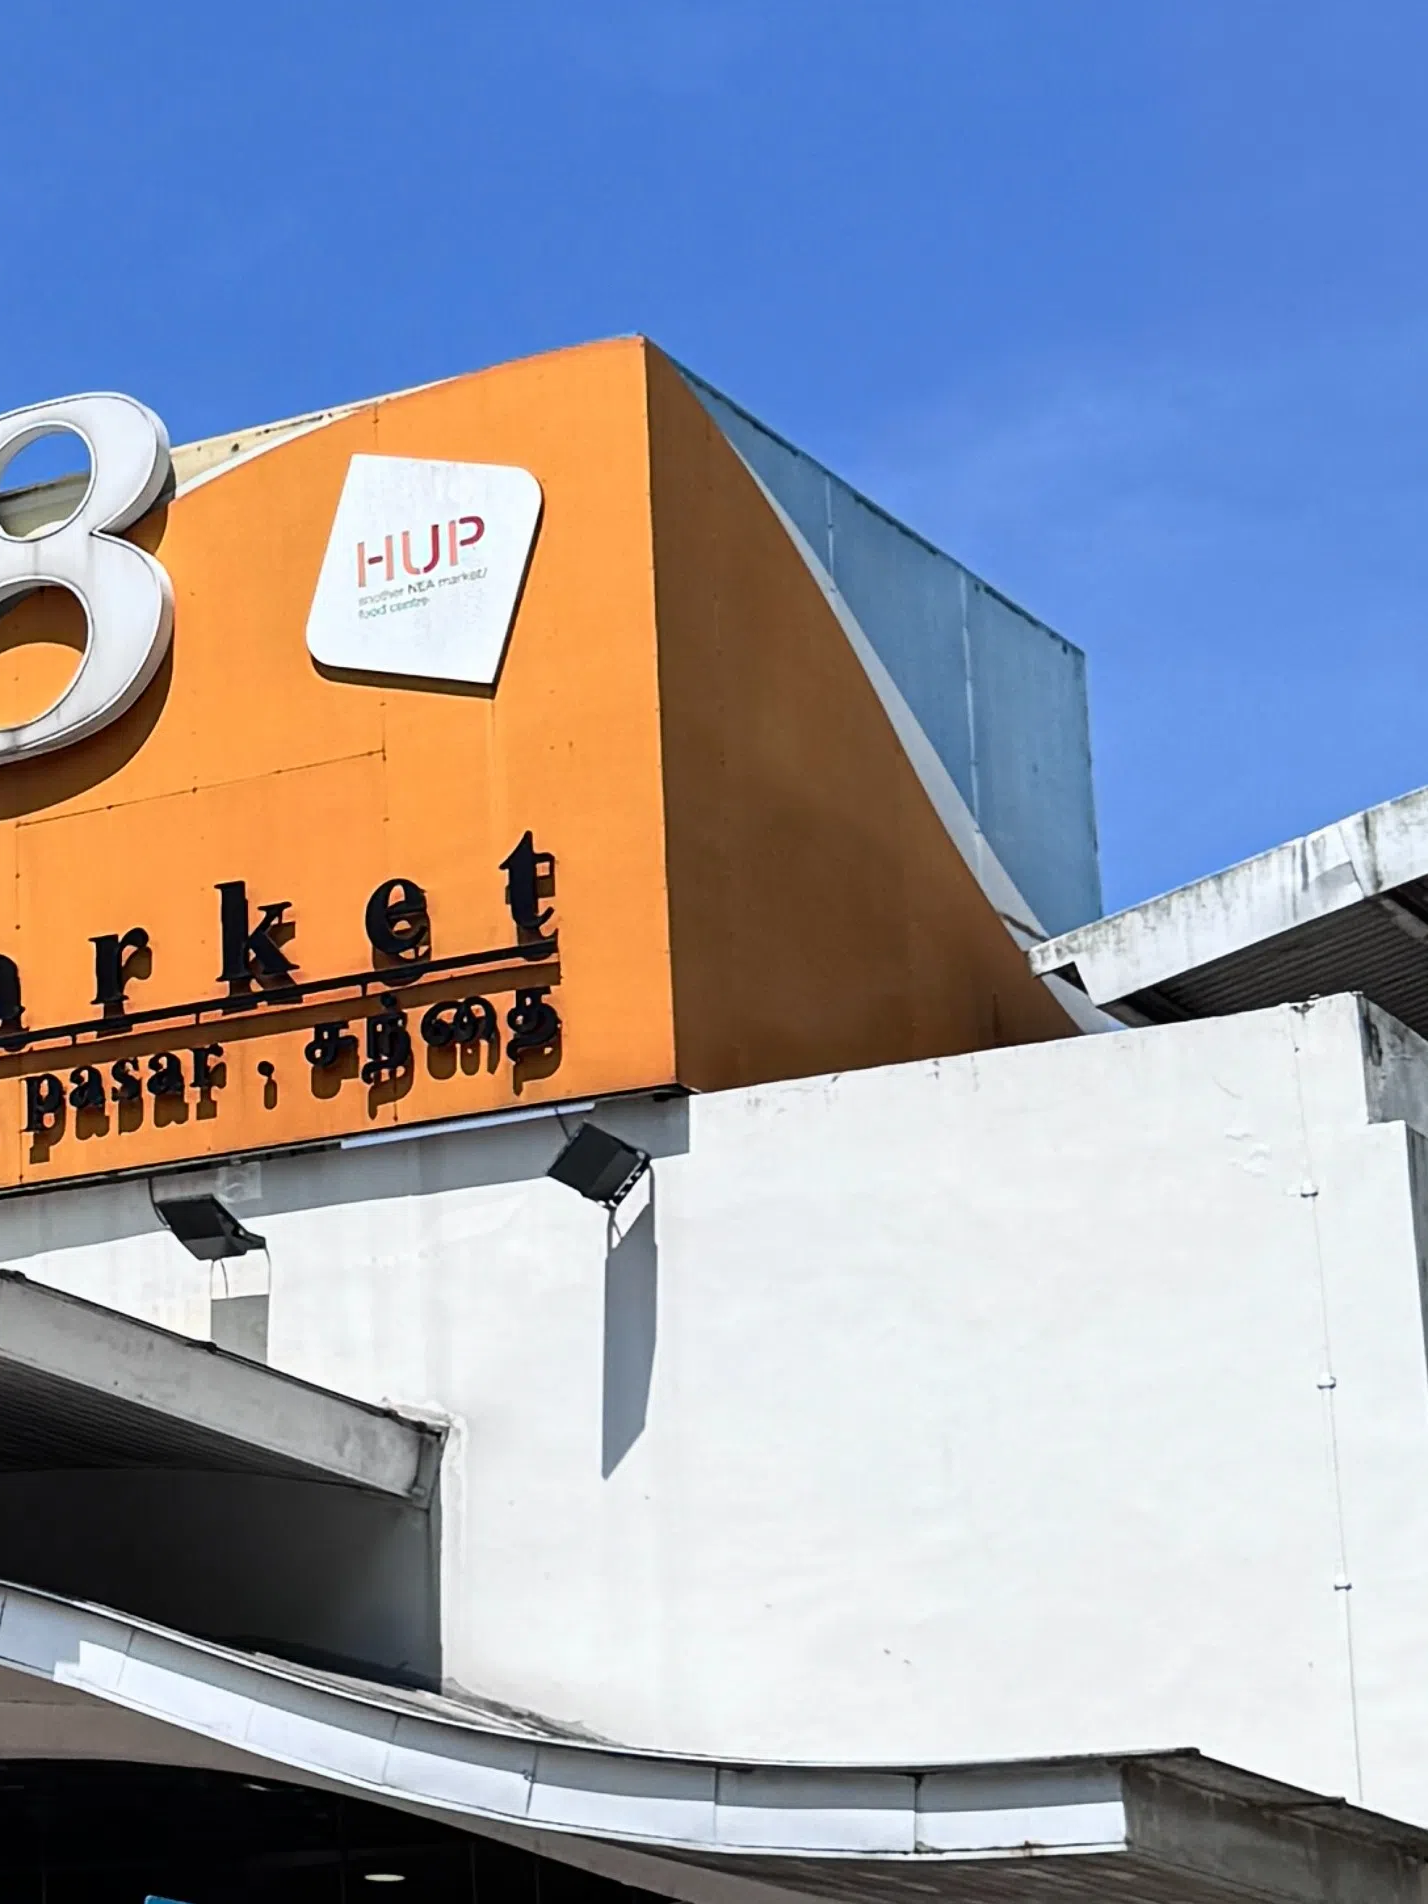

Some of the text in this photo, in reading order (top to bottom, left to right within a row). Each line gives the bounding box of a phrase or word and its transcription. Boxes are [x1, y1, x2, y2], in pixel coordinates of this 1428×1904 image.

[357, 516, 485, 587] HUP
[408, 579, 435, 594] NEA
[358, 604, 387, 619] food
[20, 1043, 223, 1133] pasar
